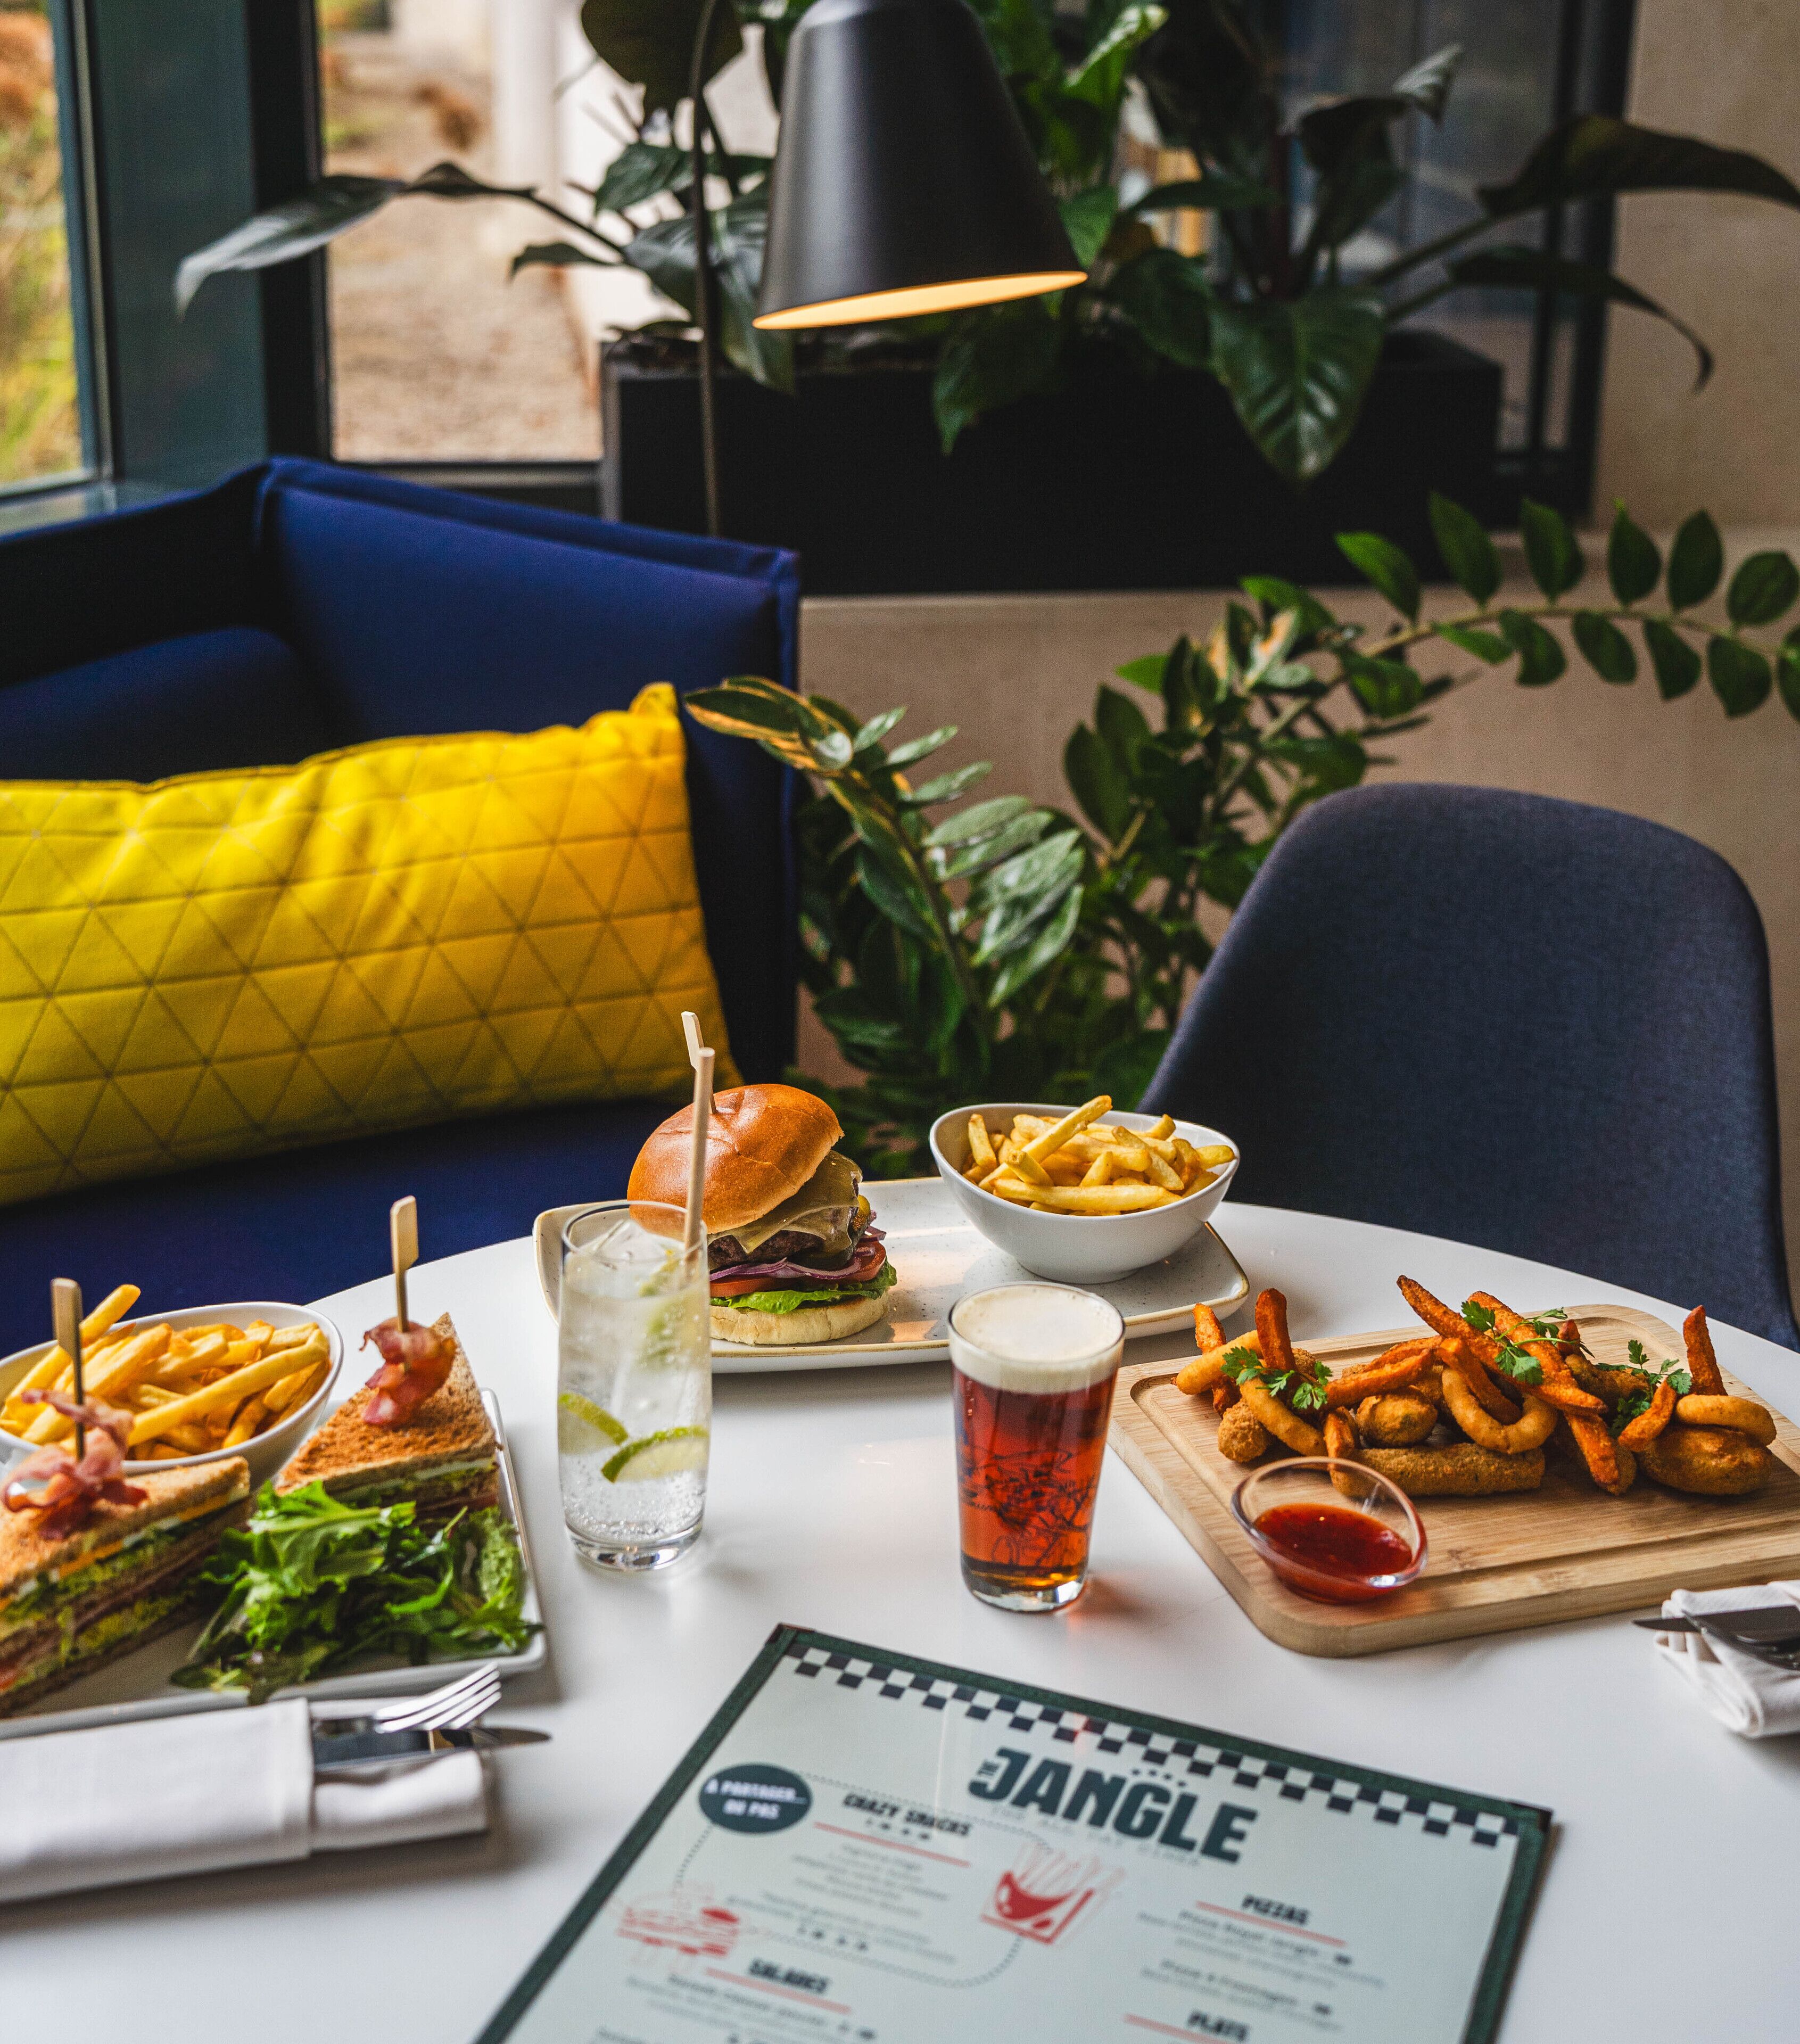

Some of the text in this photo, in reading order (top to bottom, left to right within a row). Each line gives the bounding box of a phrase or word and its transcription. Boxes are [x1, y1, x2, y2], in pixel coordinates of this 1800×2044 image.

[977, 1758, 1000, 1777] THE
[723, 1799, 780, 1819] OU PAS
[843, 1793, 901, 1818] CRAZY
[905, 1809, 972, 1837] SNACKS
[968, 1747, 1258, 1864] JANGLE
[1242, 1894, 1310, 1925] PIZZAS
[1187, 2009, 1250, 2043] PLATS
